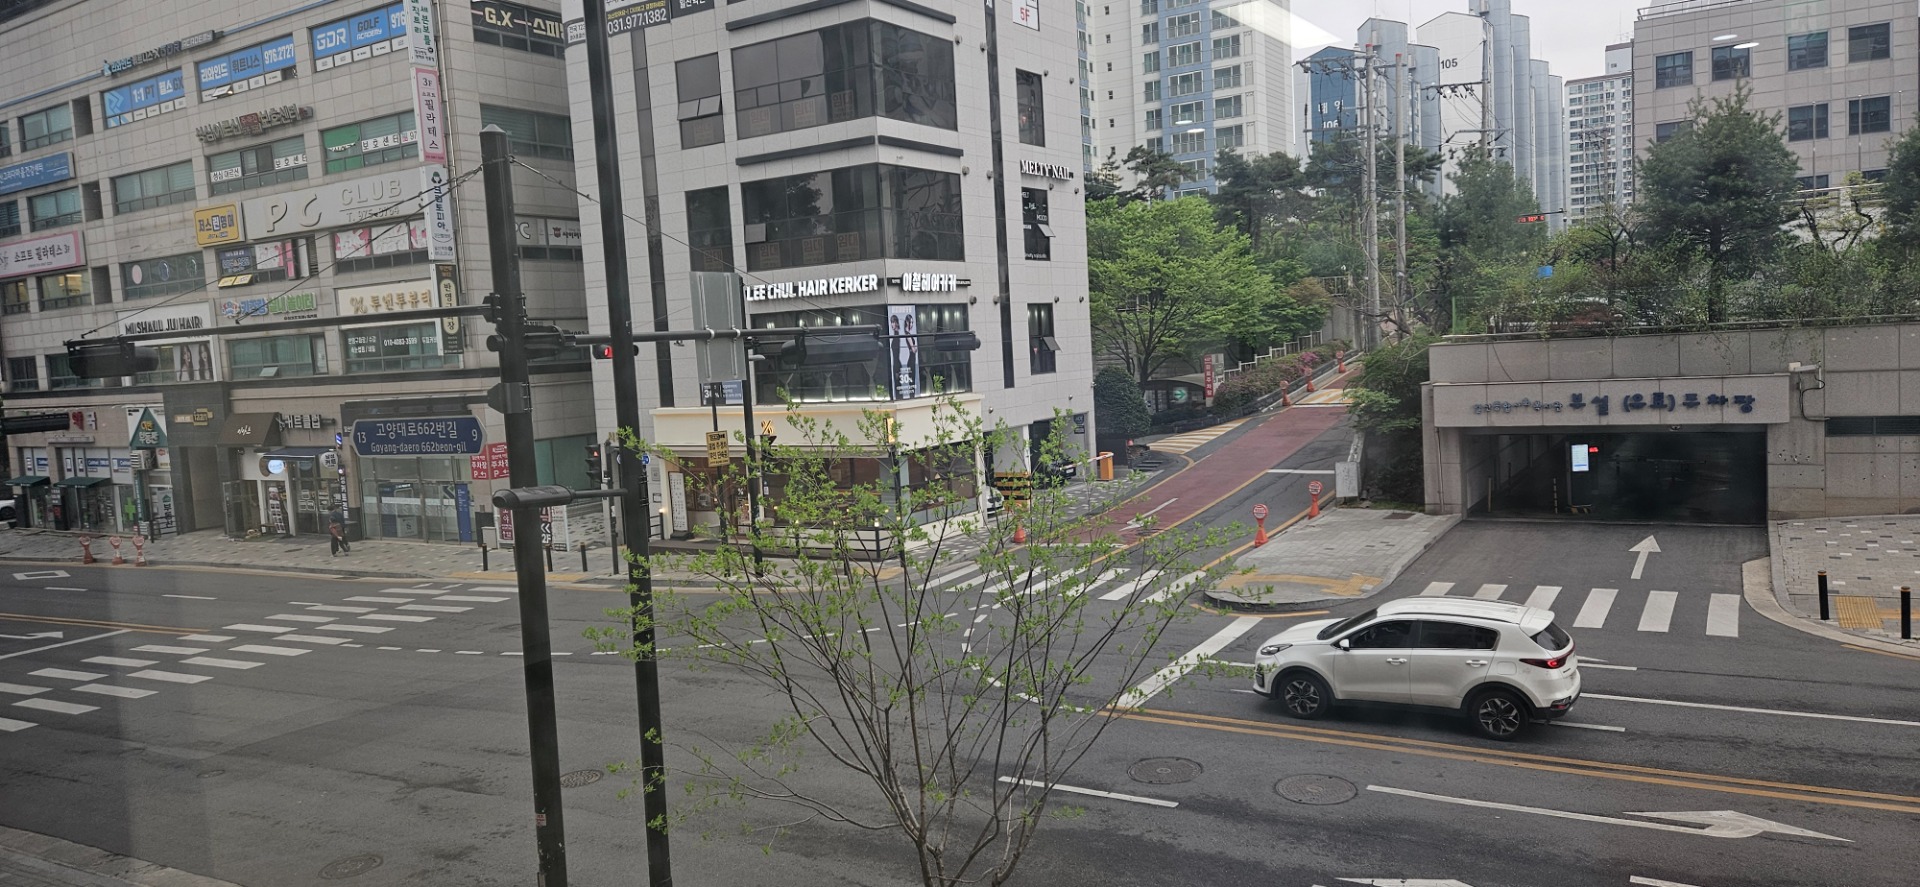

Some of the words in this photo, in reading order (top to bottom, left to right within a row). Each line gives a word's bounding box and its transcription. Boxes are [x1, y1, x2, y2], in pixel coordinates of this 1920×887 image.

[357, 16, 379, 32] GOLF
[607, 8, 667, 34] 031.977.1382
[316, 28, 346, 51] GDR
[1440, 58, 1458, 70] 105
[422, 78, 433, 87] 3F
[424, 100, 439, 149] 필라테스
[342, 180, 402, 206] CLUB
[14, 249, 34, 262] 소프트
[36, 243, 62, 260] 필라테스
[746, 284, 765, 301] LEE
[767, 281, 796, 299] CHUL
[799, 279, 828, 297] HAIR
[829, 274, 878, 295] KERKER
[179, 316, 203, 330] HAIR
[357, 432, 366, 443] 13
[376, 421, 458, 440] 고양대로662번길
[471, 428, 478, 441] 9
[371, 442, 420, 453] Goyang-daero
[421, 442, 467, 453] 662beon-gil
